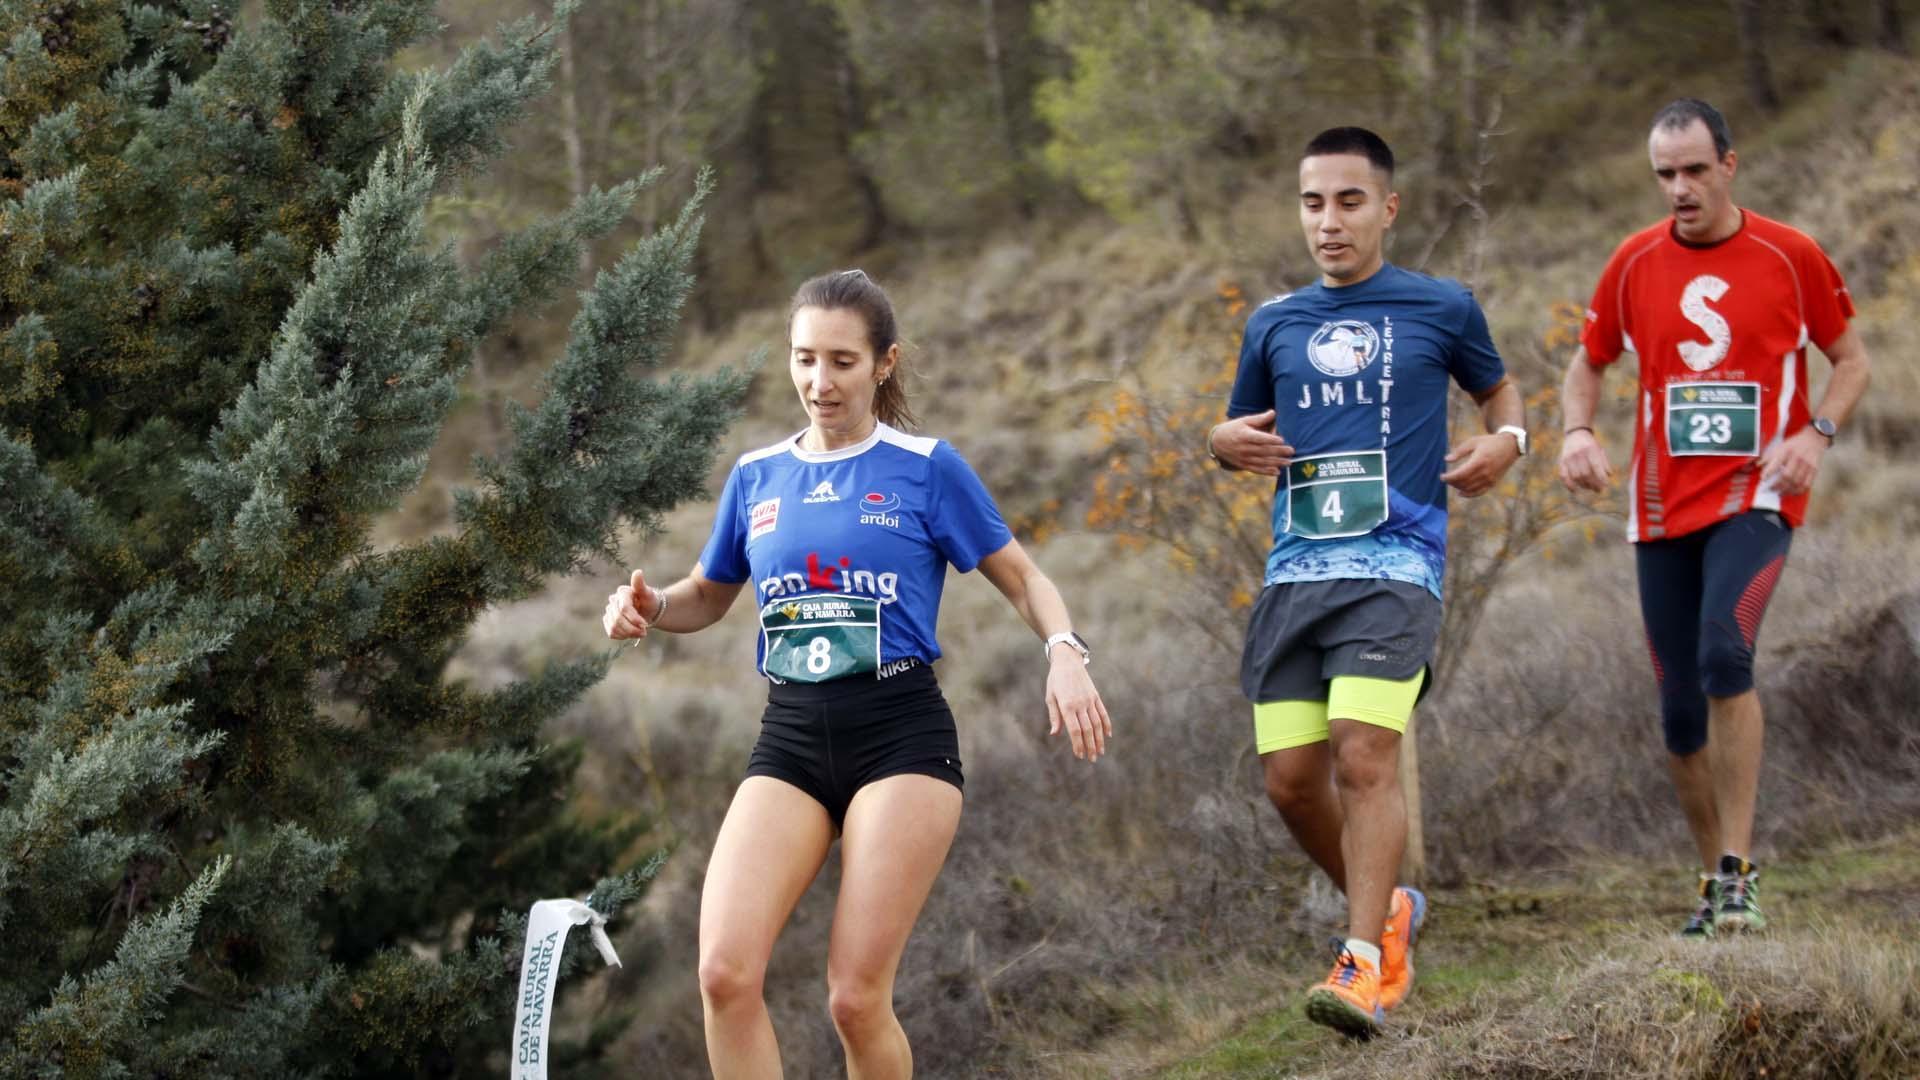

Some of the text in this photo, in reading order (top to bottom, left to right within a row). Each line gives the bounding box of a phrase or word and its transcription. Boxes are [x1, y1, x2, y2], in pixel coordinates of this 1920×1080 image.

[1676, 273, 1732, 372] S
[1689, 413, 1732, 444] 23
[753, 503, 777, 519] AVIA
[860, 513, 900, 529] ardoi
[1321, 490, 1345, 523] 4
[802, 602, 851, 612] CAJA RURAL
[803, 610, 857, 620] DE NAVARRA
[807, 636, 831, 674] 8
[877, 659, 910, 681] NIKE
[519, 939, 544, 1065] CAJA RURAL
[529, 930, 559, 1065] DE NAVARRA
